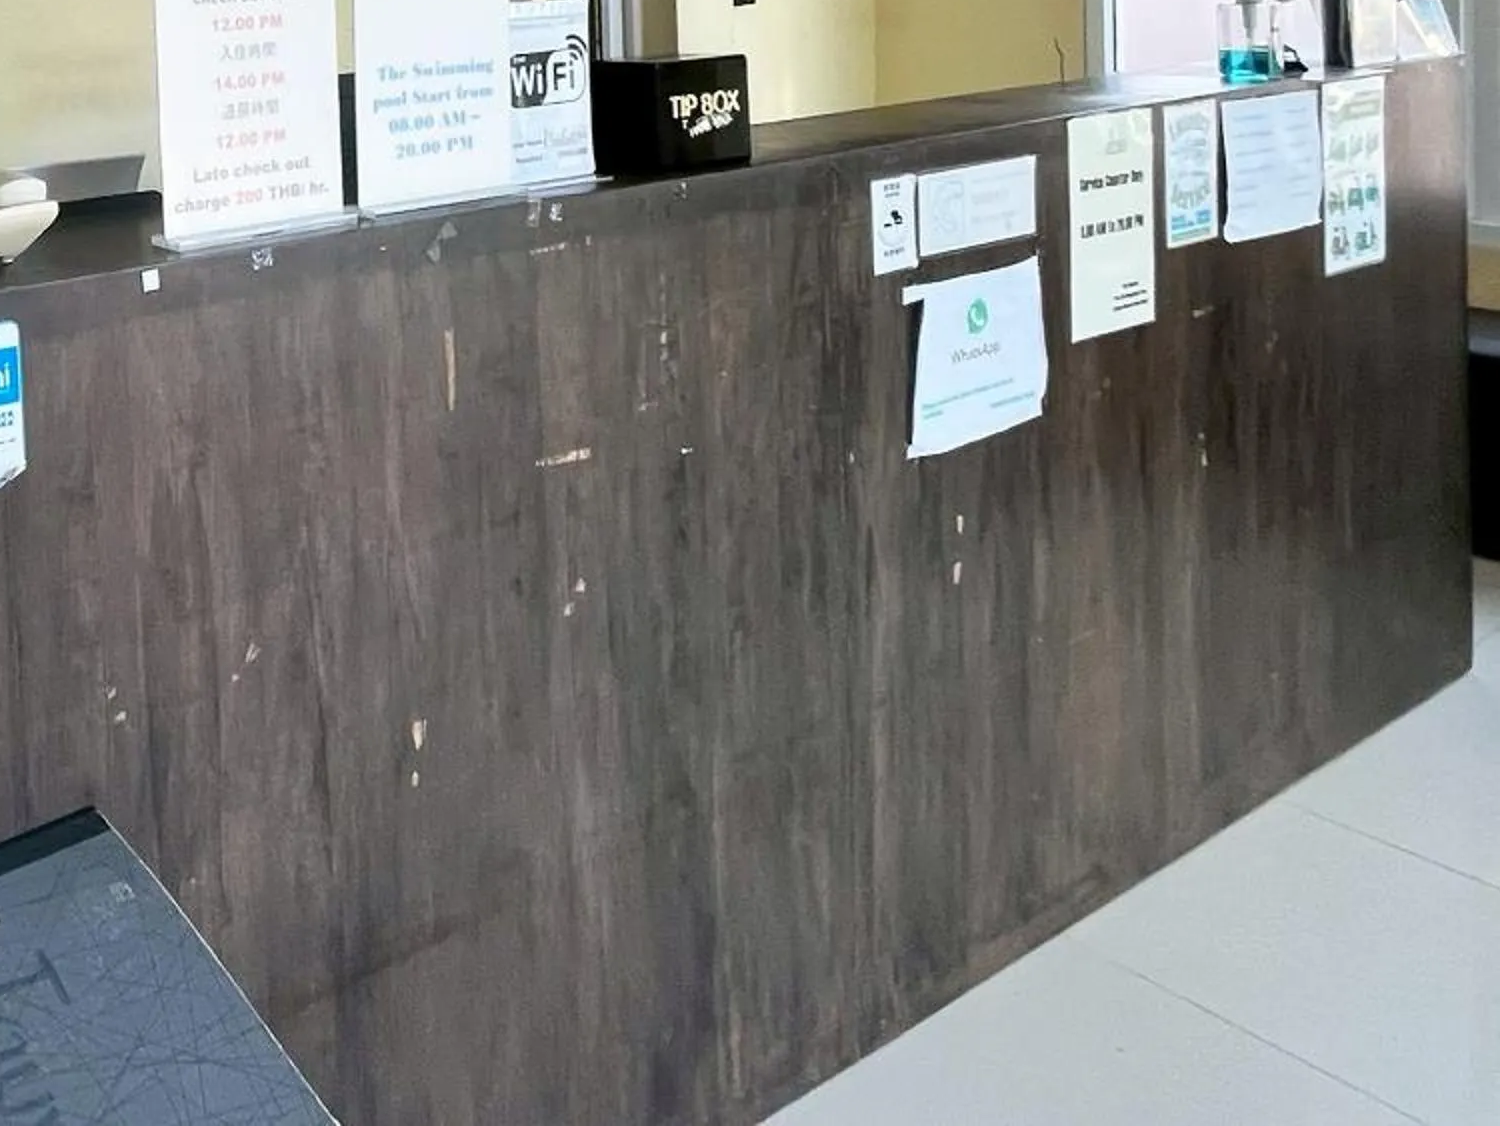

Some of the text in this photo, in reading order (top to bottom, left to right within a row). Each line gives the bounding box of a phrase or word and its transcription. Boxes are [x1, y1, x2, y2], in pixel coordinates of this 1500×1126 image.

[212, 13, 283, 32] 12.00 PM
[214, 70, 286, 92] 14.00 PM
[376, 64, 407, 82] The
[412, 57, 495, 77] Swimming
[373, 83, 494, 115] pool Start from
[668, 88, 741, 120] TIP BOX
[388, 115, 435, 134] 08.00
[441, 109, 467, 128] AM
[215, 129, 287, 151] 12.00 PM
[395, 134, 474, 160] 20.00 PM
[233, 159, 281, 177] check
[284, 156, 310, 171] out
[174, 195, 231, 214] charge
